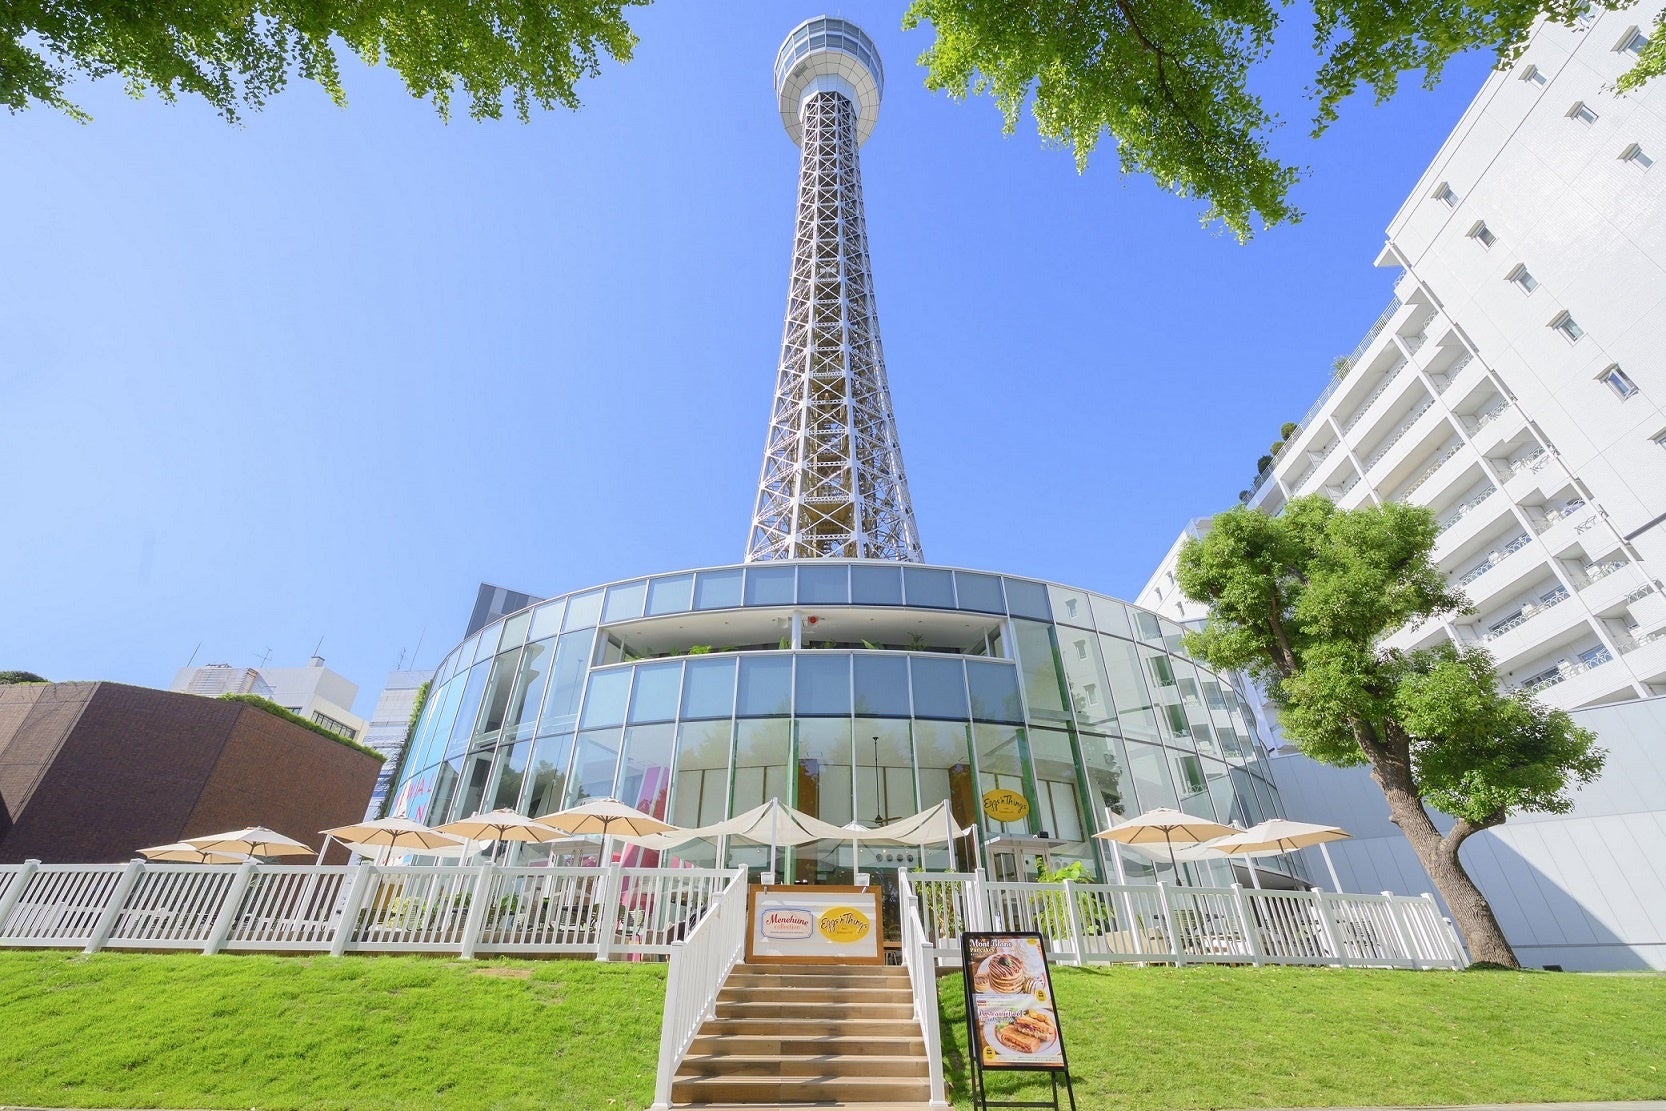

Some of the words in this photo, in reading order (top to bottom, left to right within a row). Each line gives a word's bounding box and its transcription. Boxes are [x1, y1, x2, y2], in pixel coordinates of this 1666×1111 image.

[766, 914, 808, 925] Menehune
[820, 918, 838, 933] Eggs
[843, 912, 867, 934] Things
[969, 939, 989, 947] Mont
